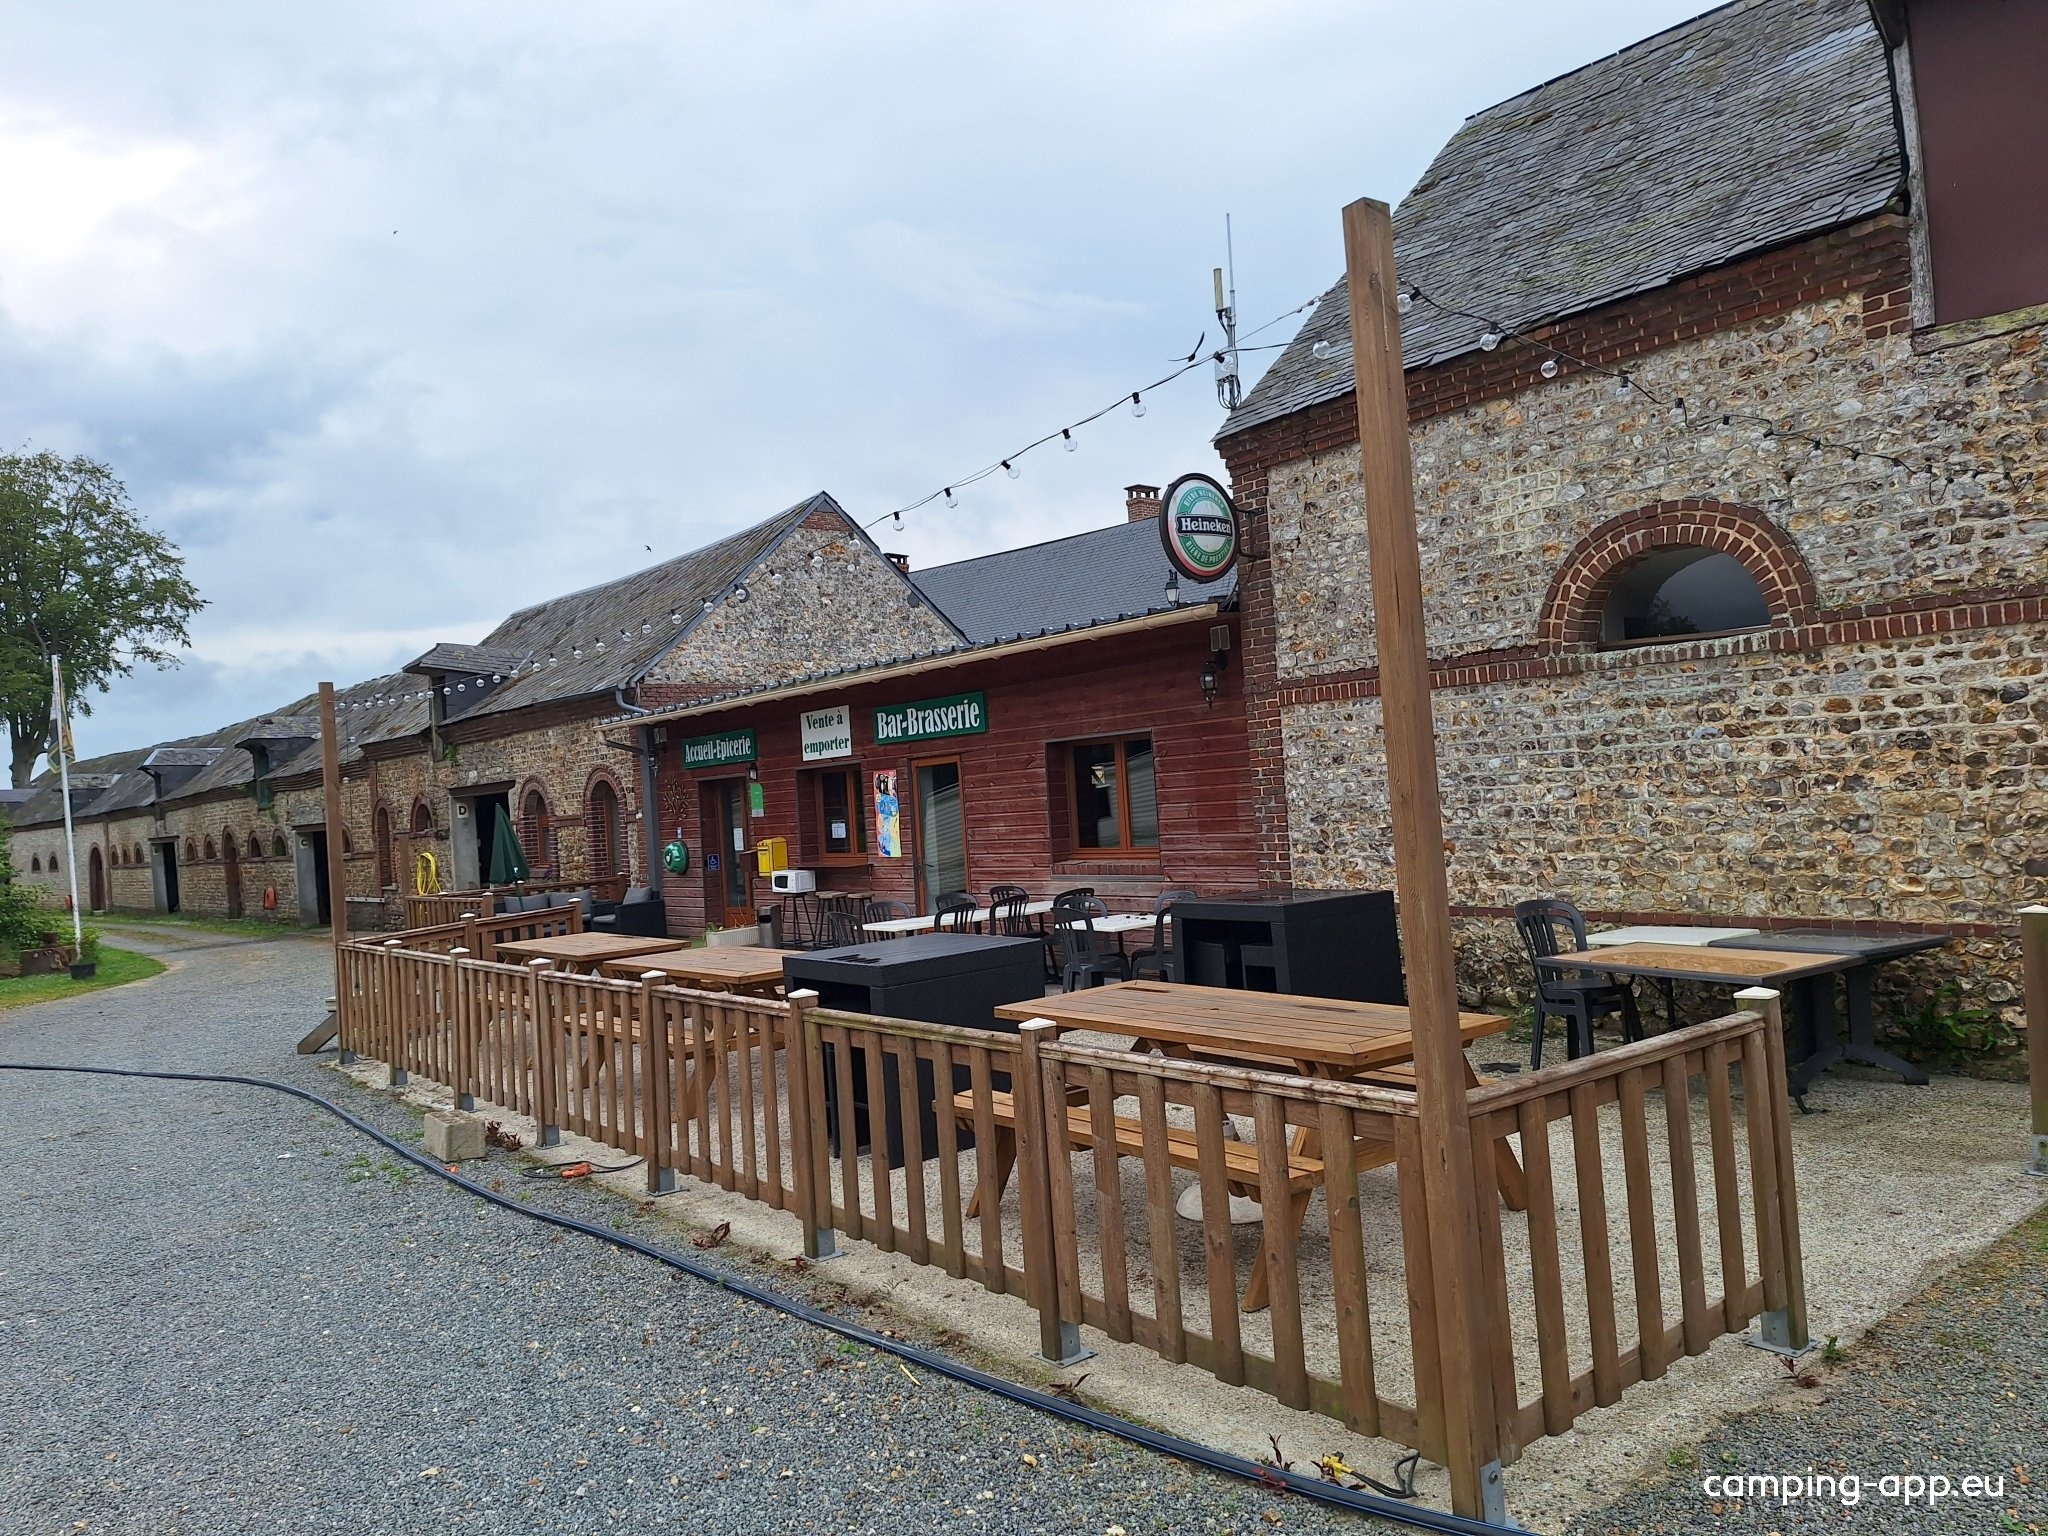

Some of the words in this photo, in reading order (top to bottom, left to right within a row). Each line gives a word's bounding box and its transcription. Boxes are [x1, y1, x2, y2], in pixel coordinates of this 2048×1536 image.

[1183, 490, 1199, 507] BIERE
[1181, 517, 1231, 534] Heineken
[1186, 540, 1201, 560] BIERE
[806, 713, 835, 730] Vente
[837, 709, 843, 725] à
[877, 699, 980, 739] Bar-Brasserie
[685, 735, 751, 762] Accueil-Epicerie
[804, 736, 849, 756] emporter
[458, 805, 467, 815] D
[300, 839, 309, 847] C
